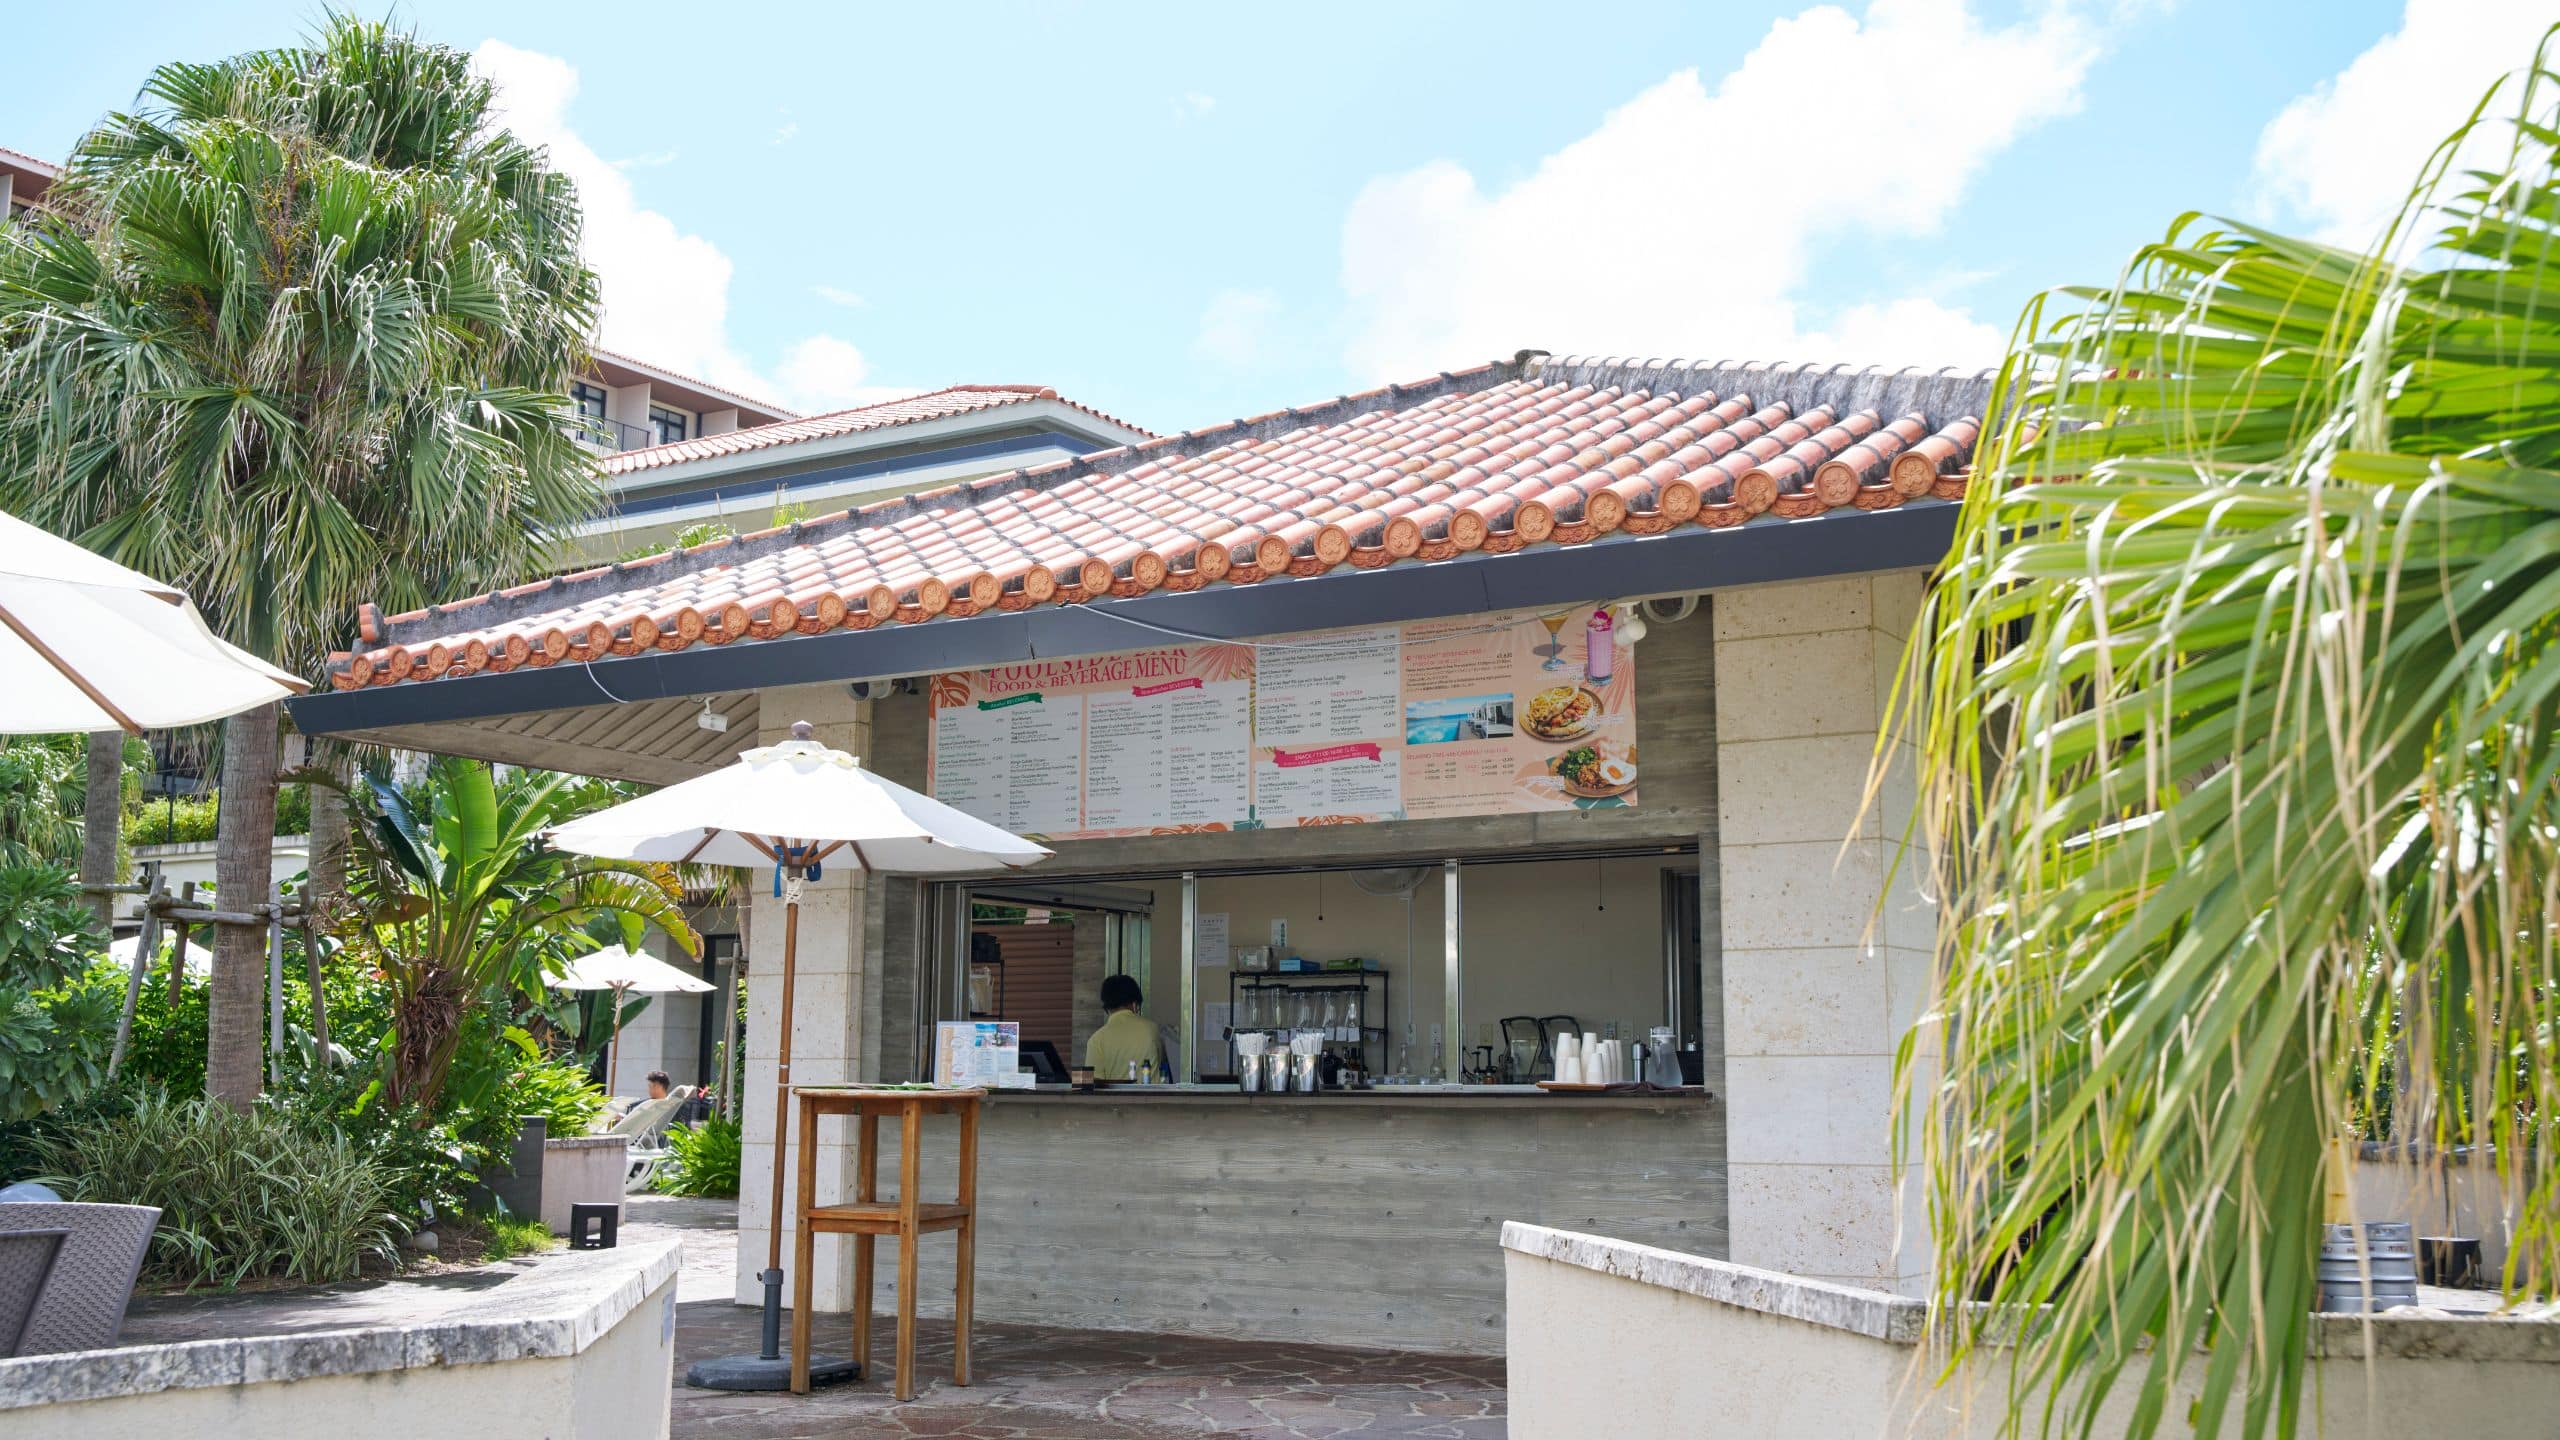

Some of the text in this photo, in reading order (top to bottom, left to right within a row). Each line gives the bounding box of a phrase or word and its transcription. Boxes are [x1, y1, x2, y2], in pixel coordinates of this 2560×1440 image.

[989, 655, 1187, 693] FOOD & BEVERAGE MENU
